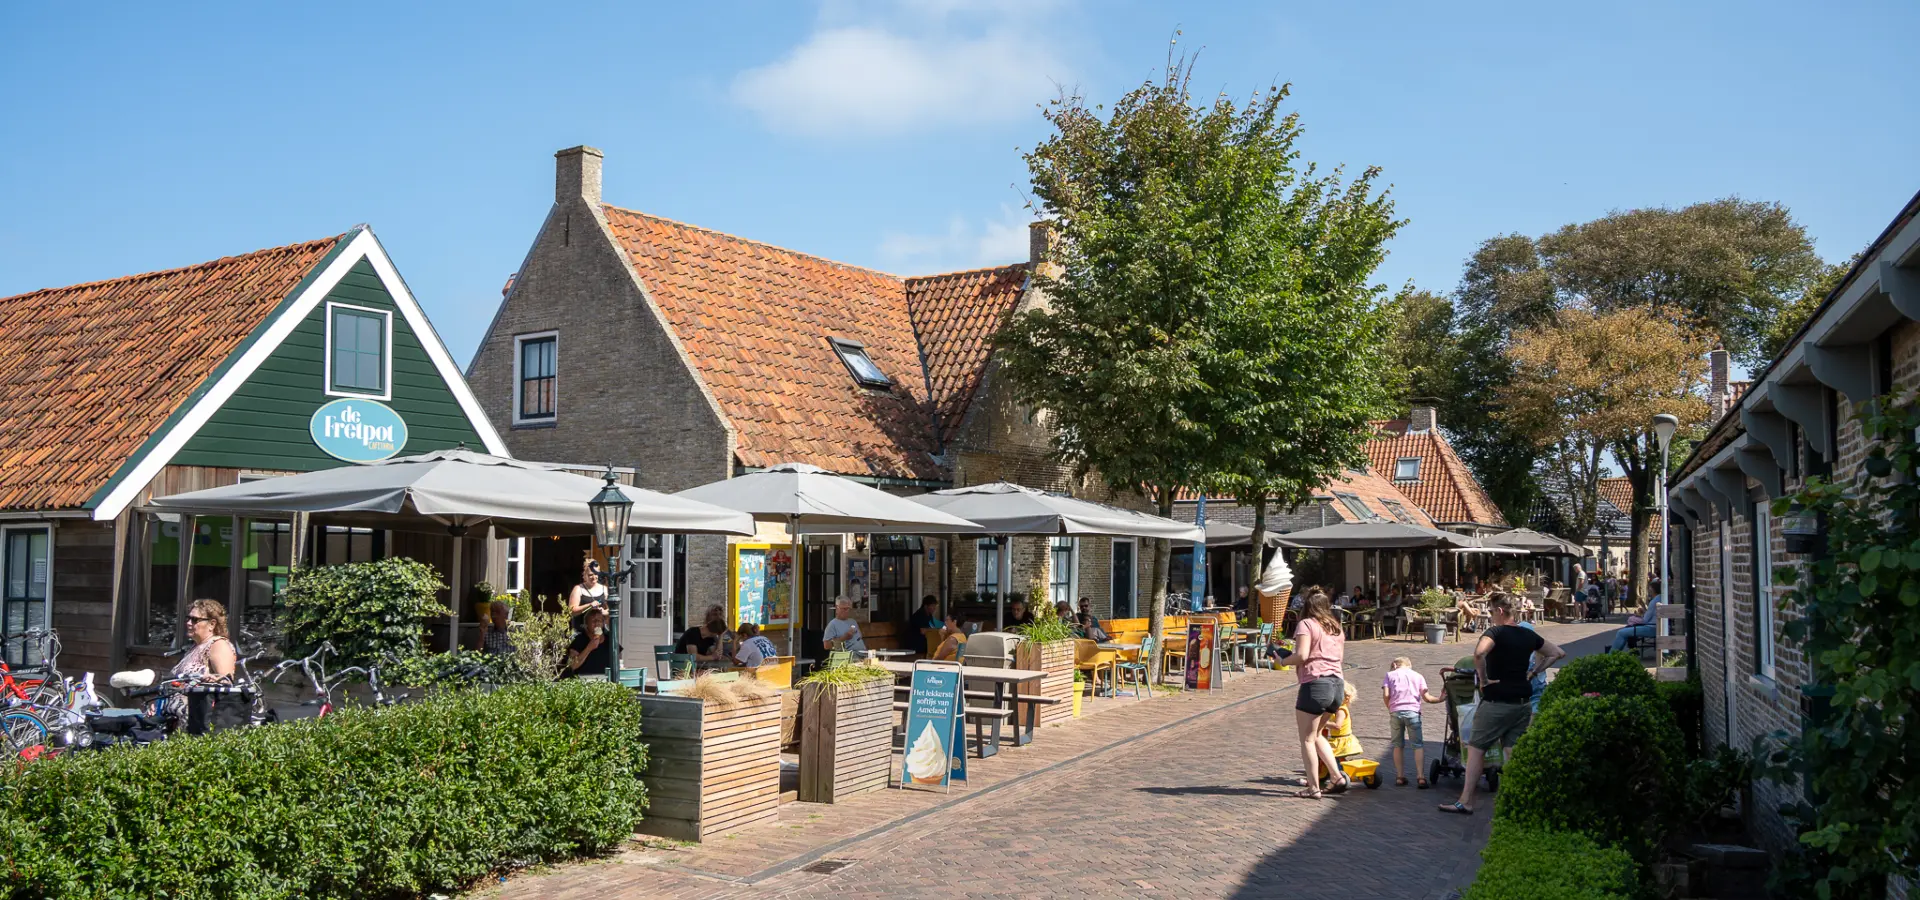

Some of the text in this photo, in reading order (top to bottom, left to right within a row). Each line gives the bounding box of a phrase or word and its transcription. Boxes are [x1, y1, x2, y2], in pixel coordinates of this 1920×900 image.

[341, 405, 361, 423] de
[324, 415, 394, 446] Fretpot
[926, 690, 954, 698] lekkerste
[917, 698, 936, 706] softijs
